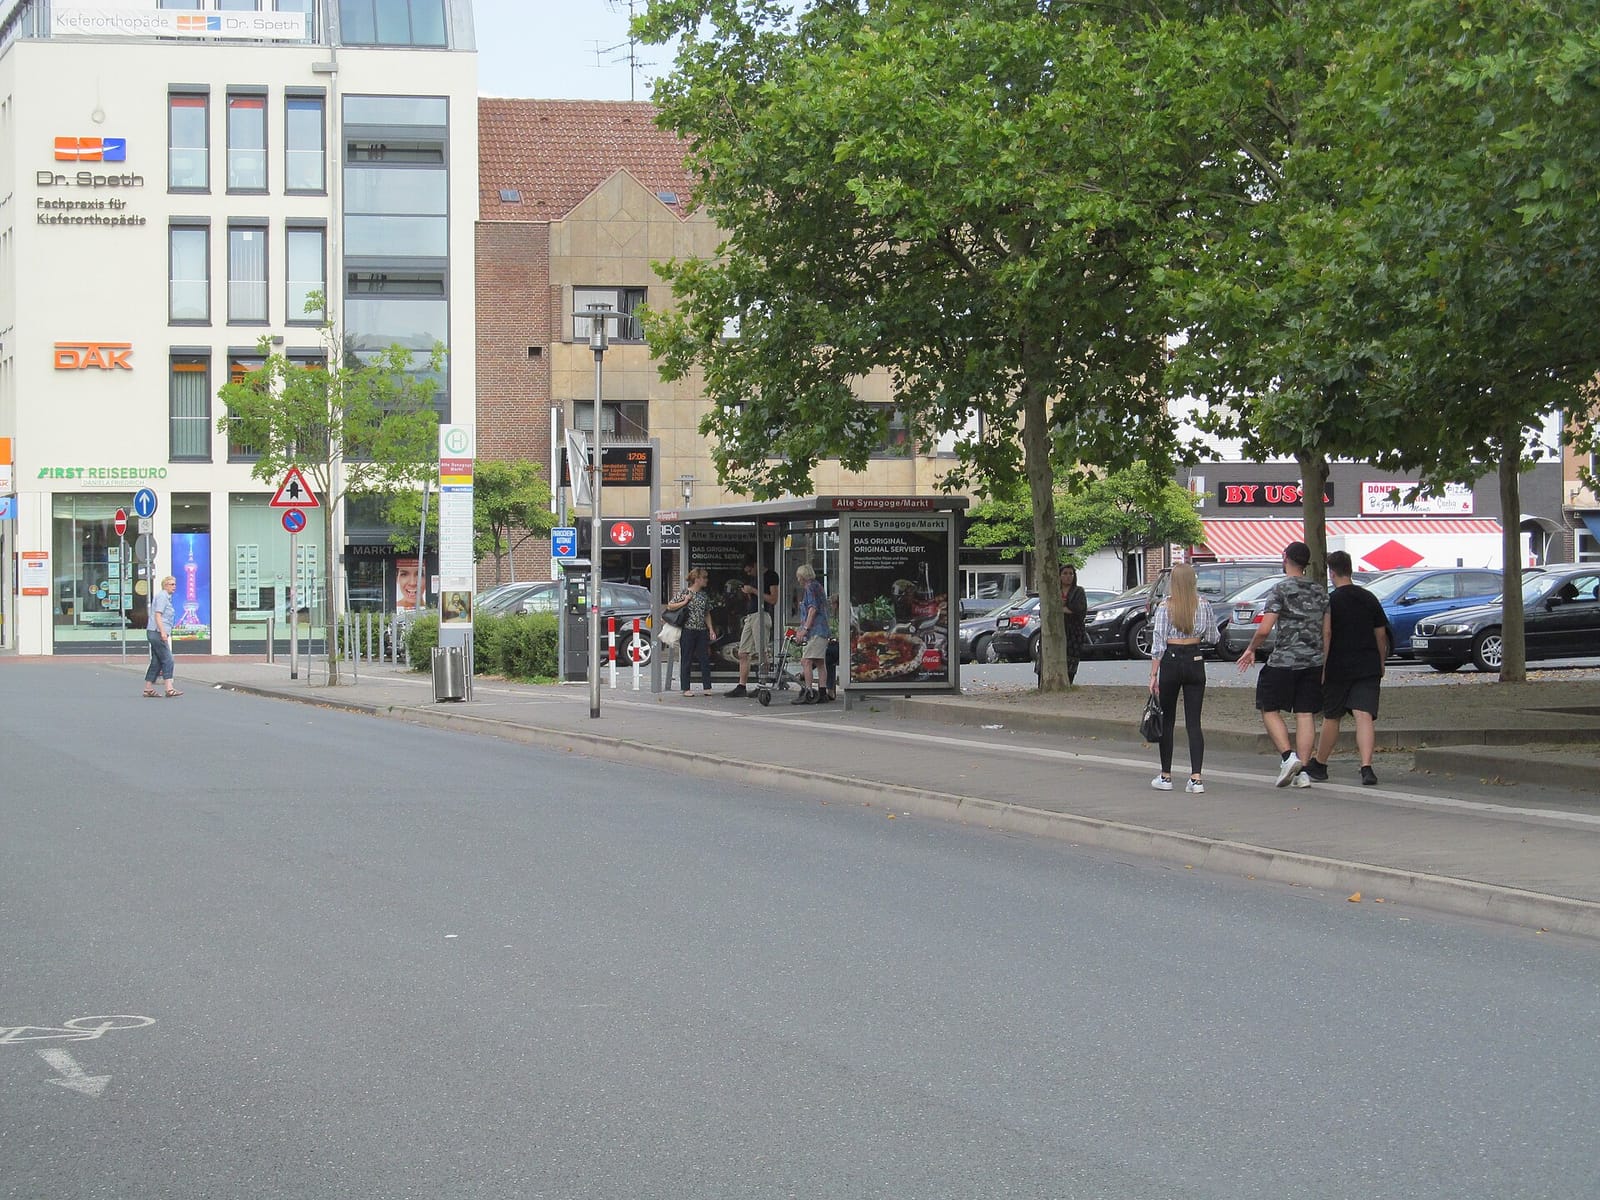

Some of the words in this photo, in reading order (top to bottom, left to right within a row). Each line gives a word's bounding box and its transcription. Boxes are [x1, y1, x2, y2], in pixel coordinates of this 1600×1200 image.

[226, 18, 249, 29] Dr.
[253, 18, 300, 31] Speth
[36, 171, 69, 186] Dr.
[76, 171, 144, 188] Speth
[36, 197, 105, 211] Fachpraxis
[109, 197, 127, 209] für
[36, 213, 147, 228] Kieferorthopädie
[54, 341, 134, 370] DAK
[451, 434, 463, 449] H
[37, 467, 84, 479] FIRST
[88, 466, 168, 479] REISEBÜRO
[1225, 485, 1259, 503] BY
[836, 498, 855, 507] Alte
[857, 498, 929, 509] Synagoge/Markt
[853, 520, 871, 528] Alte
[873, 520, 945, 529] Synagoge/Markt
[870, 538, 908, 546] ORIGINAL,
